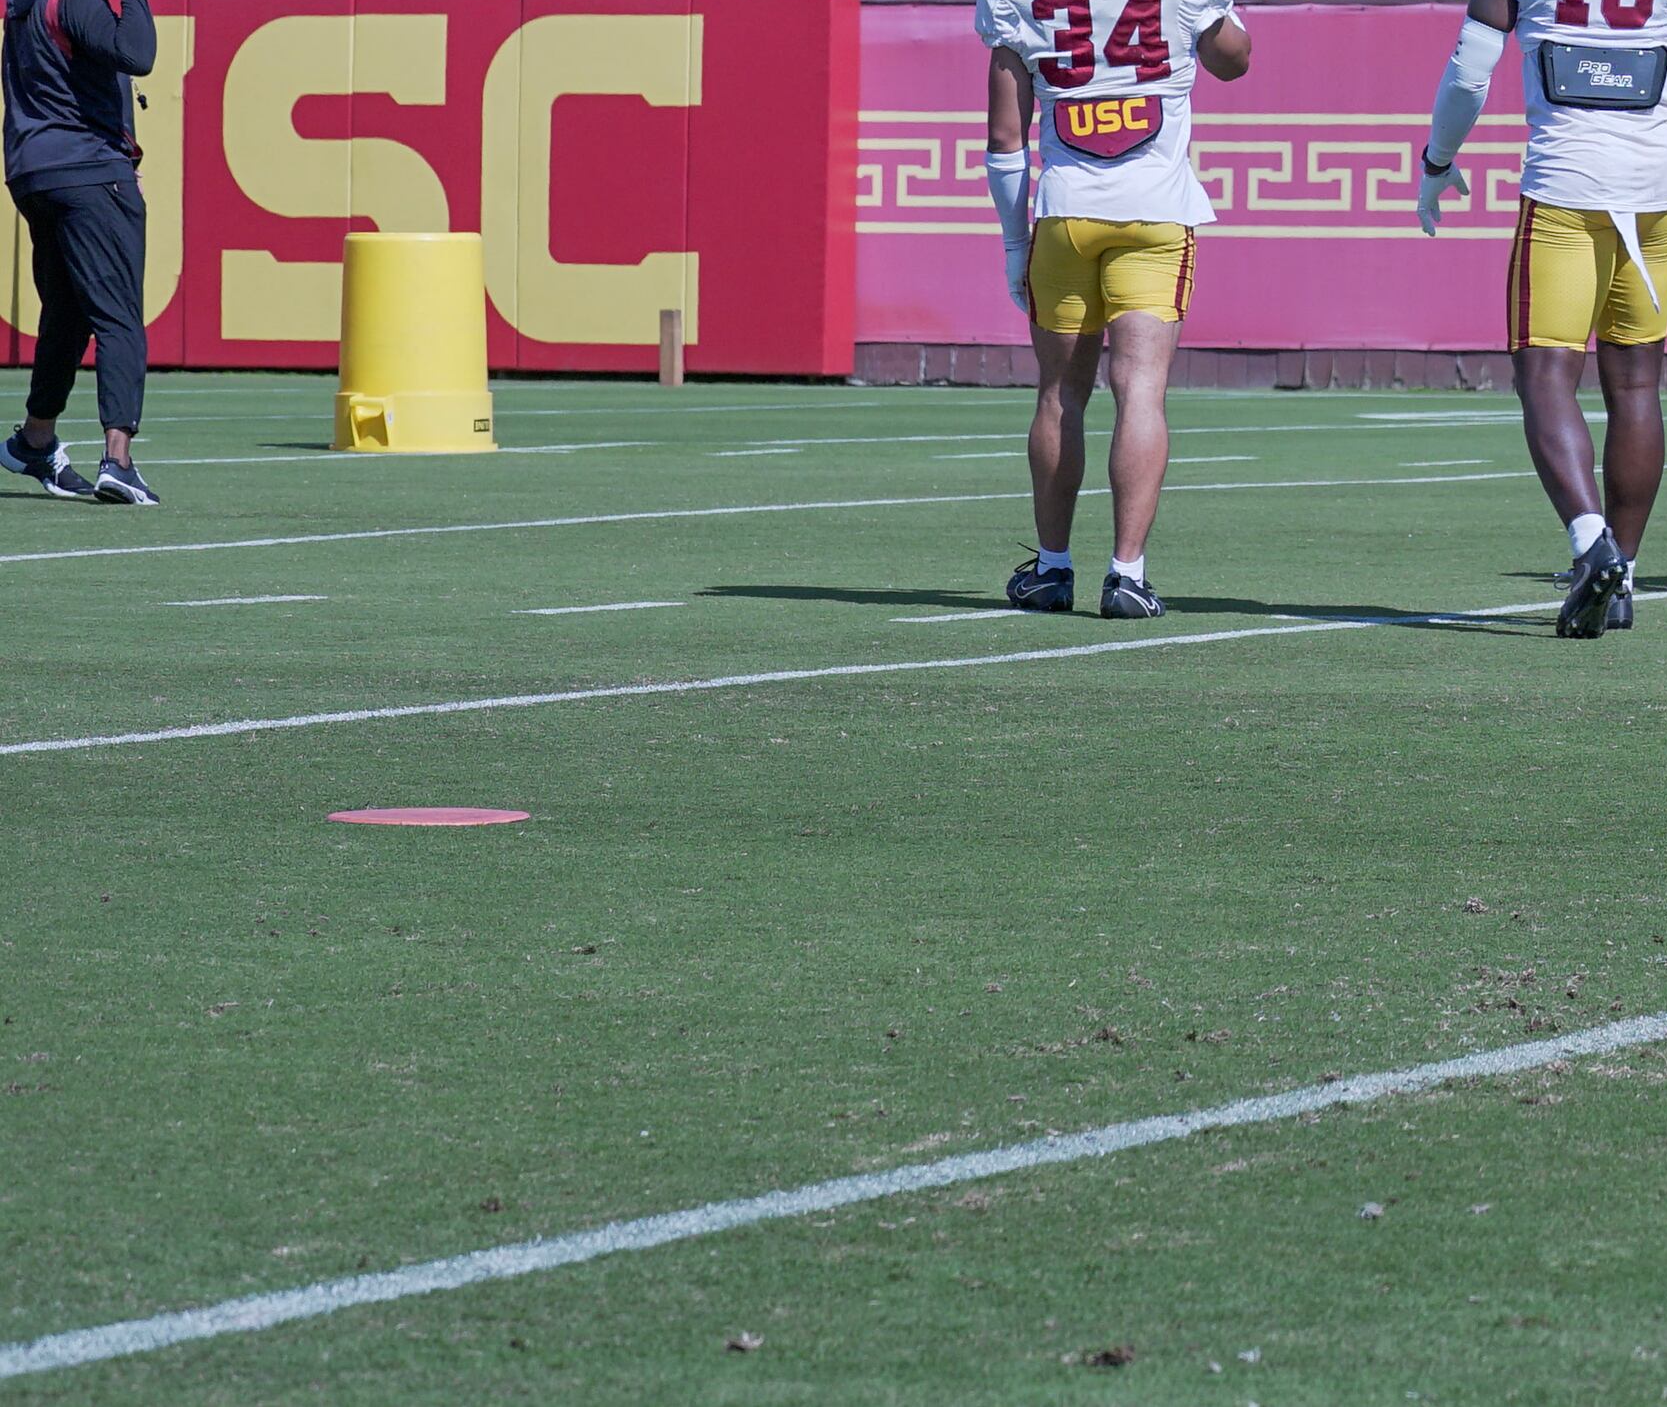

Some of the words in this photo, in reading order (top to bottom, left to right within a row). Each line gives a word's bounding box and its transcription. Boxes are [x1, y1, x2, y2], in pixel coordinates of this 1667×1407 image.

[1577, 60, 1612, 74] PRO
[1589, 73, 1634, 88] GEAR
[1068, 97, 1149, 137] USC
